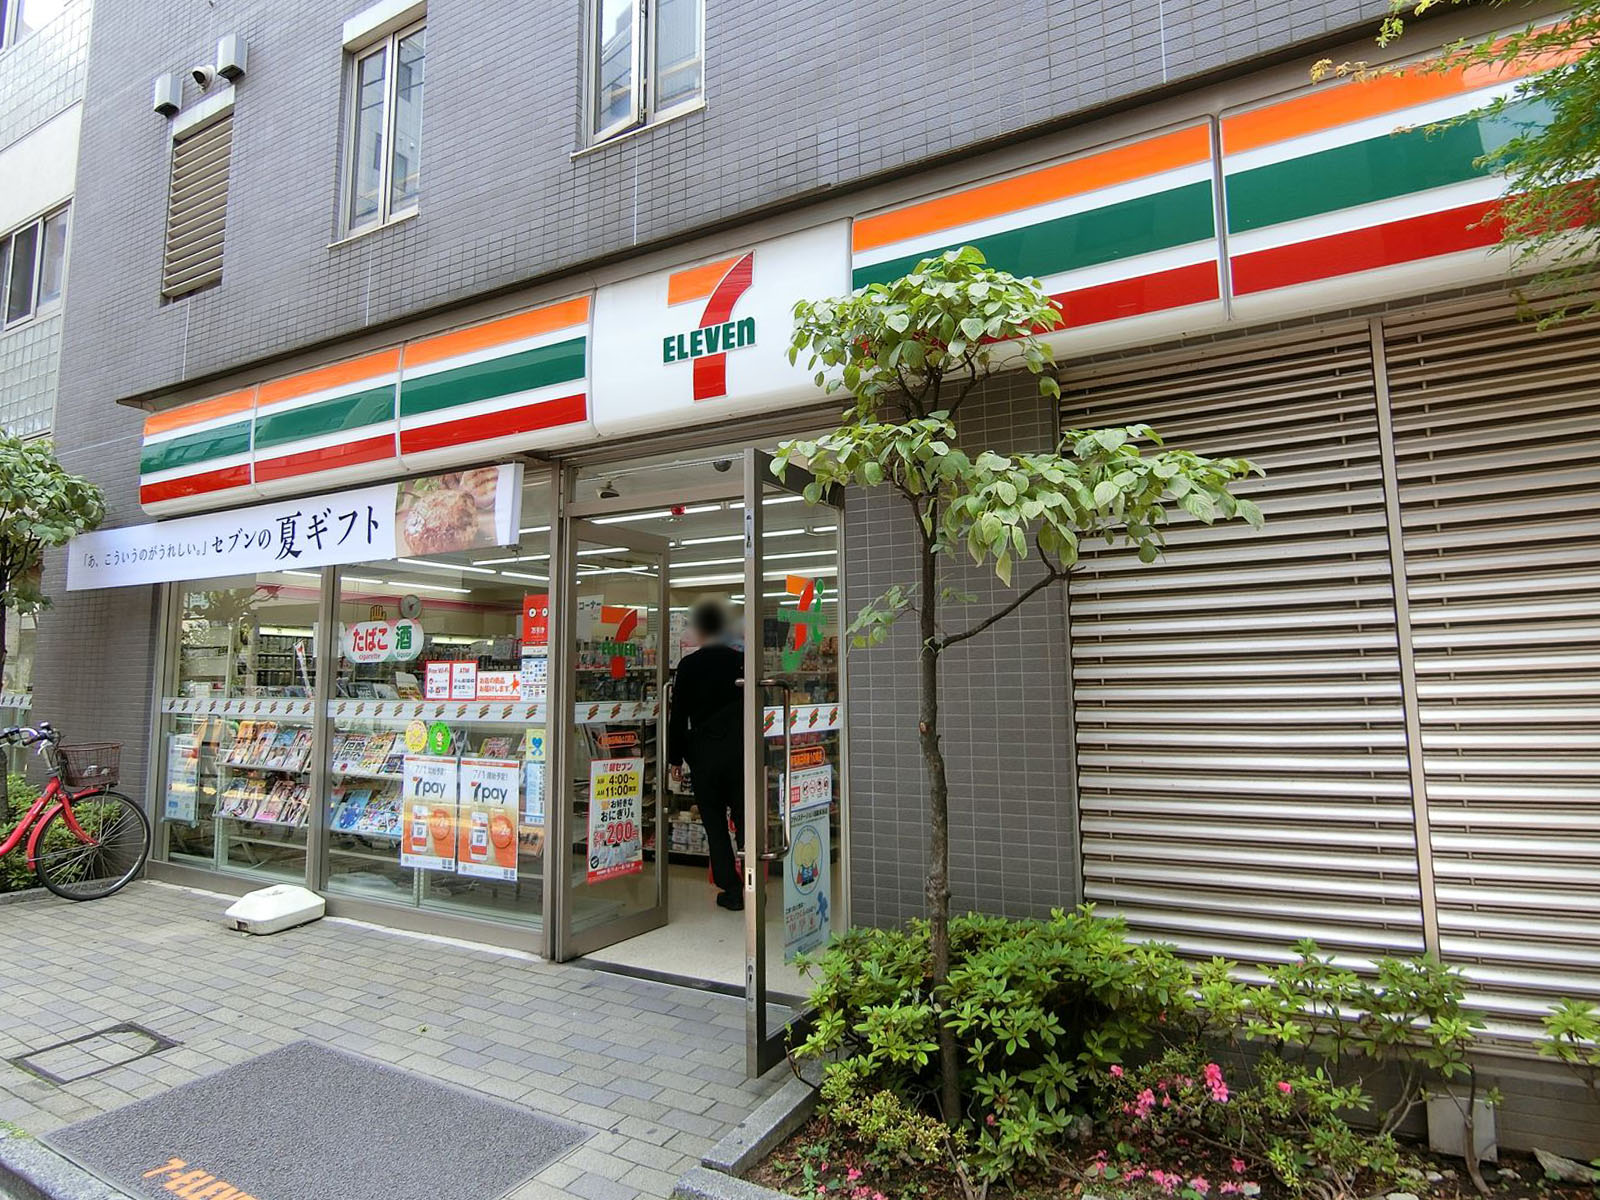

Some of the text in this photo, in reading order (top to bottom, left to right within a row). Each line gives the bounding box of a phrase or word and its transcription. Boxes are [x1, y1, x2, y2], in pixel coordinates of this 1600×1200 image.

[353, 625, 412, 652] たばこ 酒
